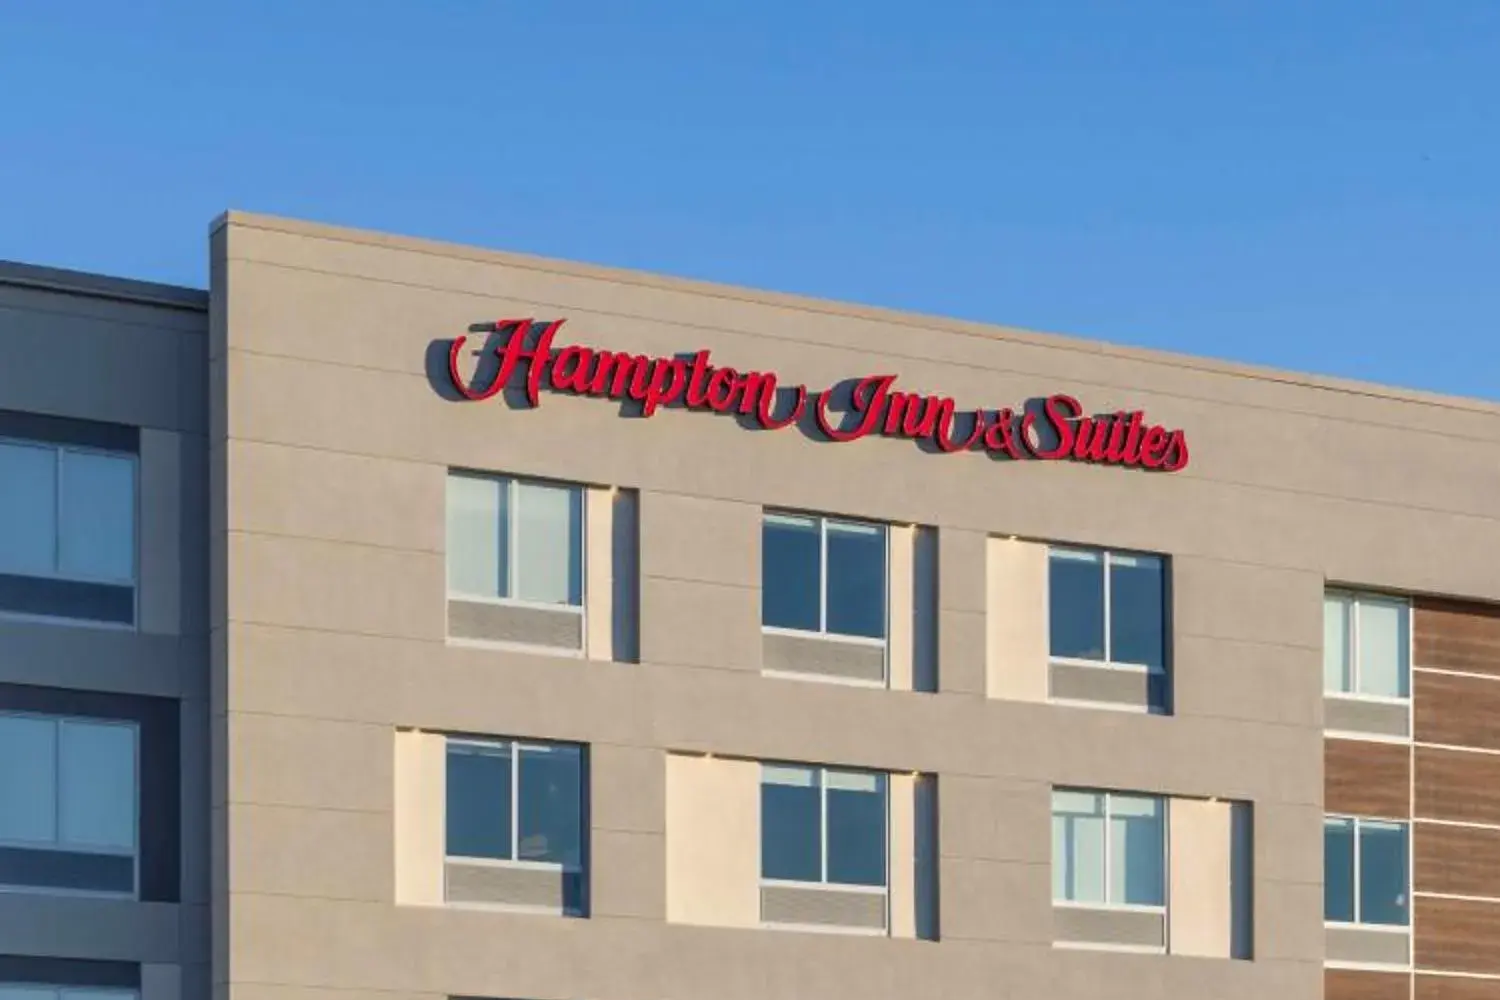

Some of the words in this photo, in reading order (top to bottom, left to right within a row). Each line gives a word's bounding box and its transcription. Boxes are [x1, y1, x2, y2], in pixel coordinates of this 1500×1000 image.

[450, 318, 807, 430] Hampton
[817, 374, 982, 452] Inn
[984, 408, 1023, 460] &
[1023, 394, 1189, 472] Suites
